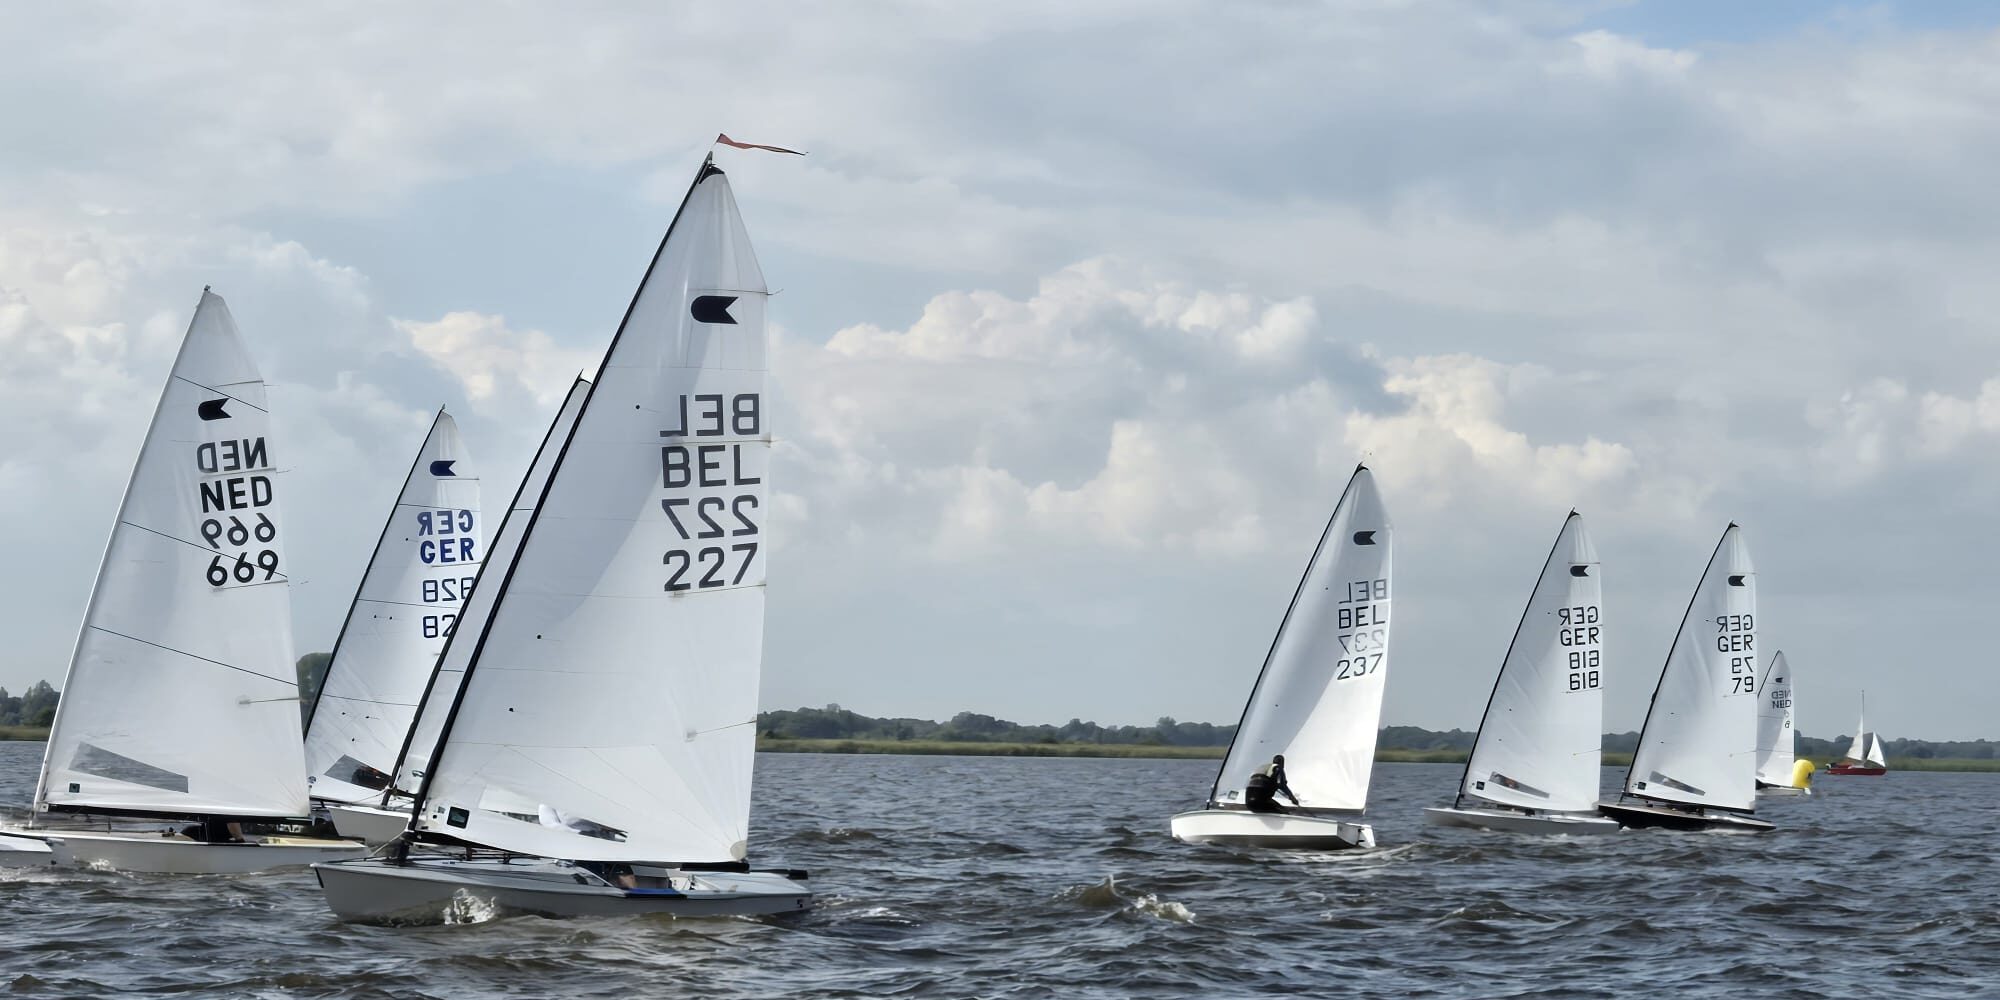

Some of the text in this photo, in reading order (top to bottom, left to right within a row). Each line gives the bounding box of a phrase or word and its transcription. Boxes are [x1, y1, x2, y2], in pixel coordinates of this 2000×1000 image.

[661, 444, 761, 488] BEL
[199, 475, 273, 513] NED
[420, 537, 475, 564] GER
[206, 549, 279, 587] 669
[662, 542, 758, 591] 227
[422, 614, 457, 638] 82
[1338, 604, 1386, 630] BEL
[1559, 626, 1600, 647] GER
[1717, 634, 1754, 652] GER
[1336, 652, 1384, 680] 237
[1569, 670, 1599, 691] 618
[1731, 676, 1754, 694] 79
[1772, 699, 1791, 709] NED
